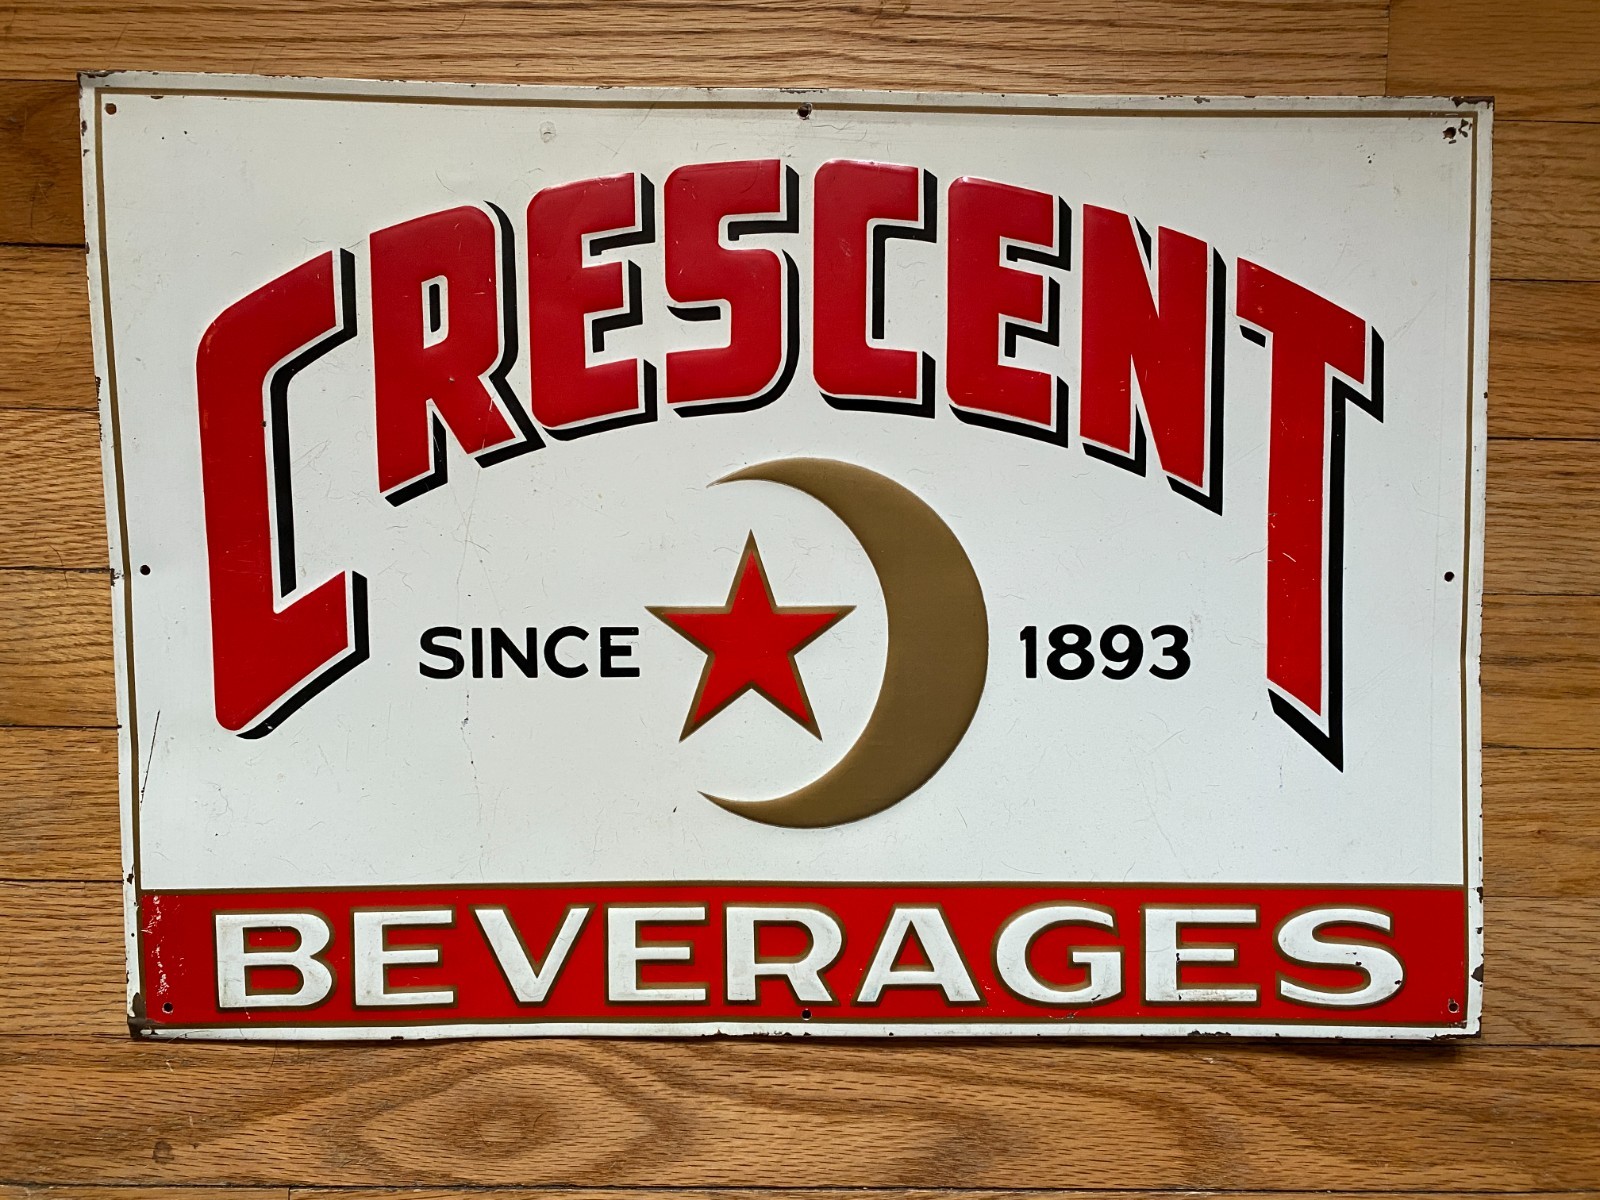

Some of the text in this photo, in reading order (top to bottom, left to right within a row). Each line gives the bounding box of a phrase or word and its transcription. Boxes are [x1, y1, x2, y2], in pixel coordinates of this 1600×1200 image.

[196, 159, 1384, 772] CRESCENT
[419, 624, 1192, 681] SINCE 1893
[213, 904, 1406, 1009] BEVERAGES
